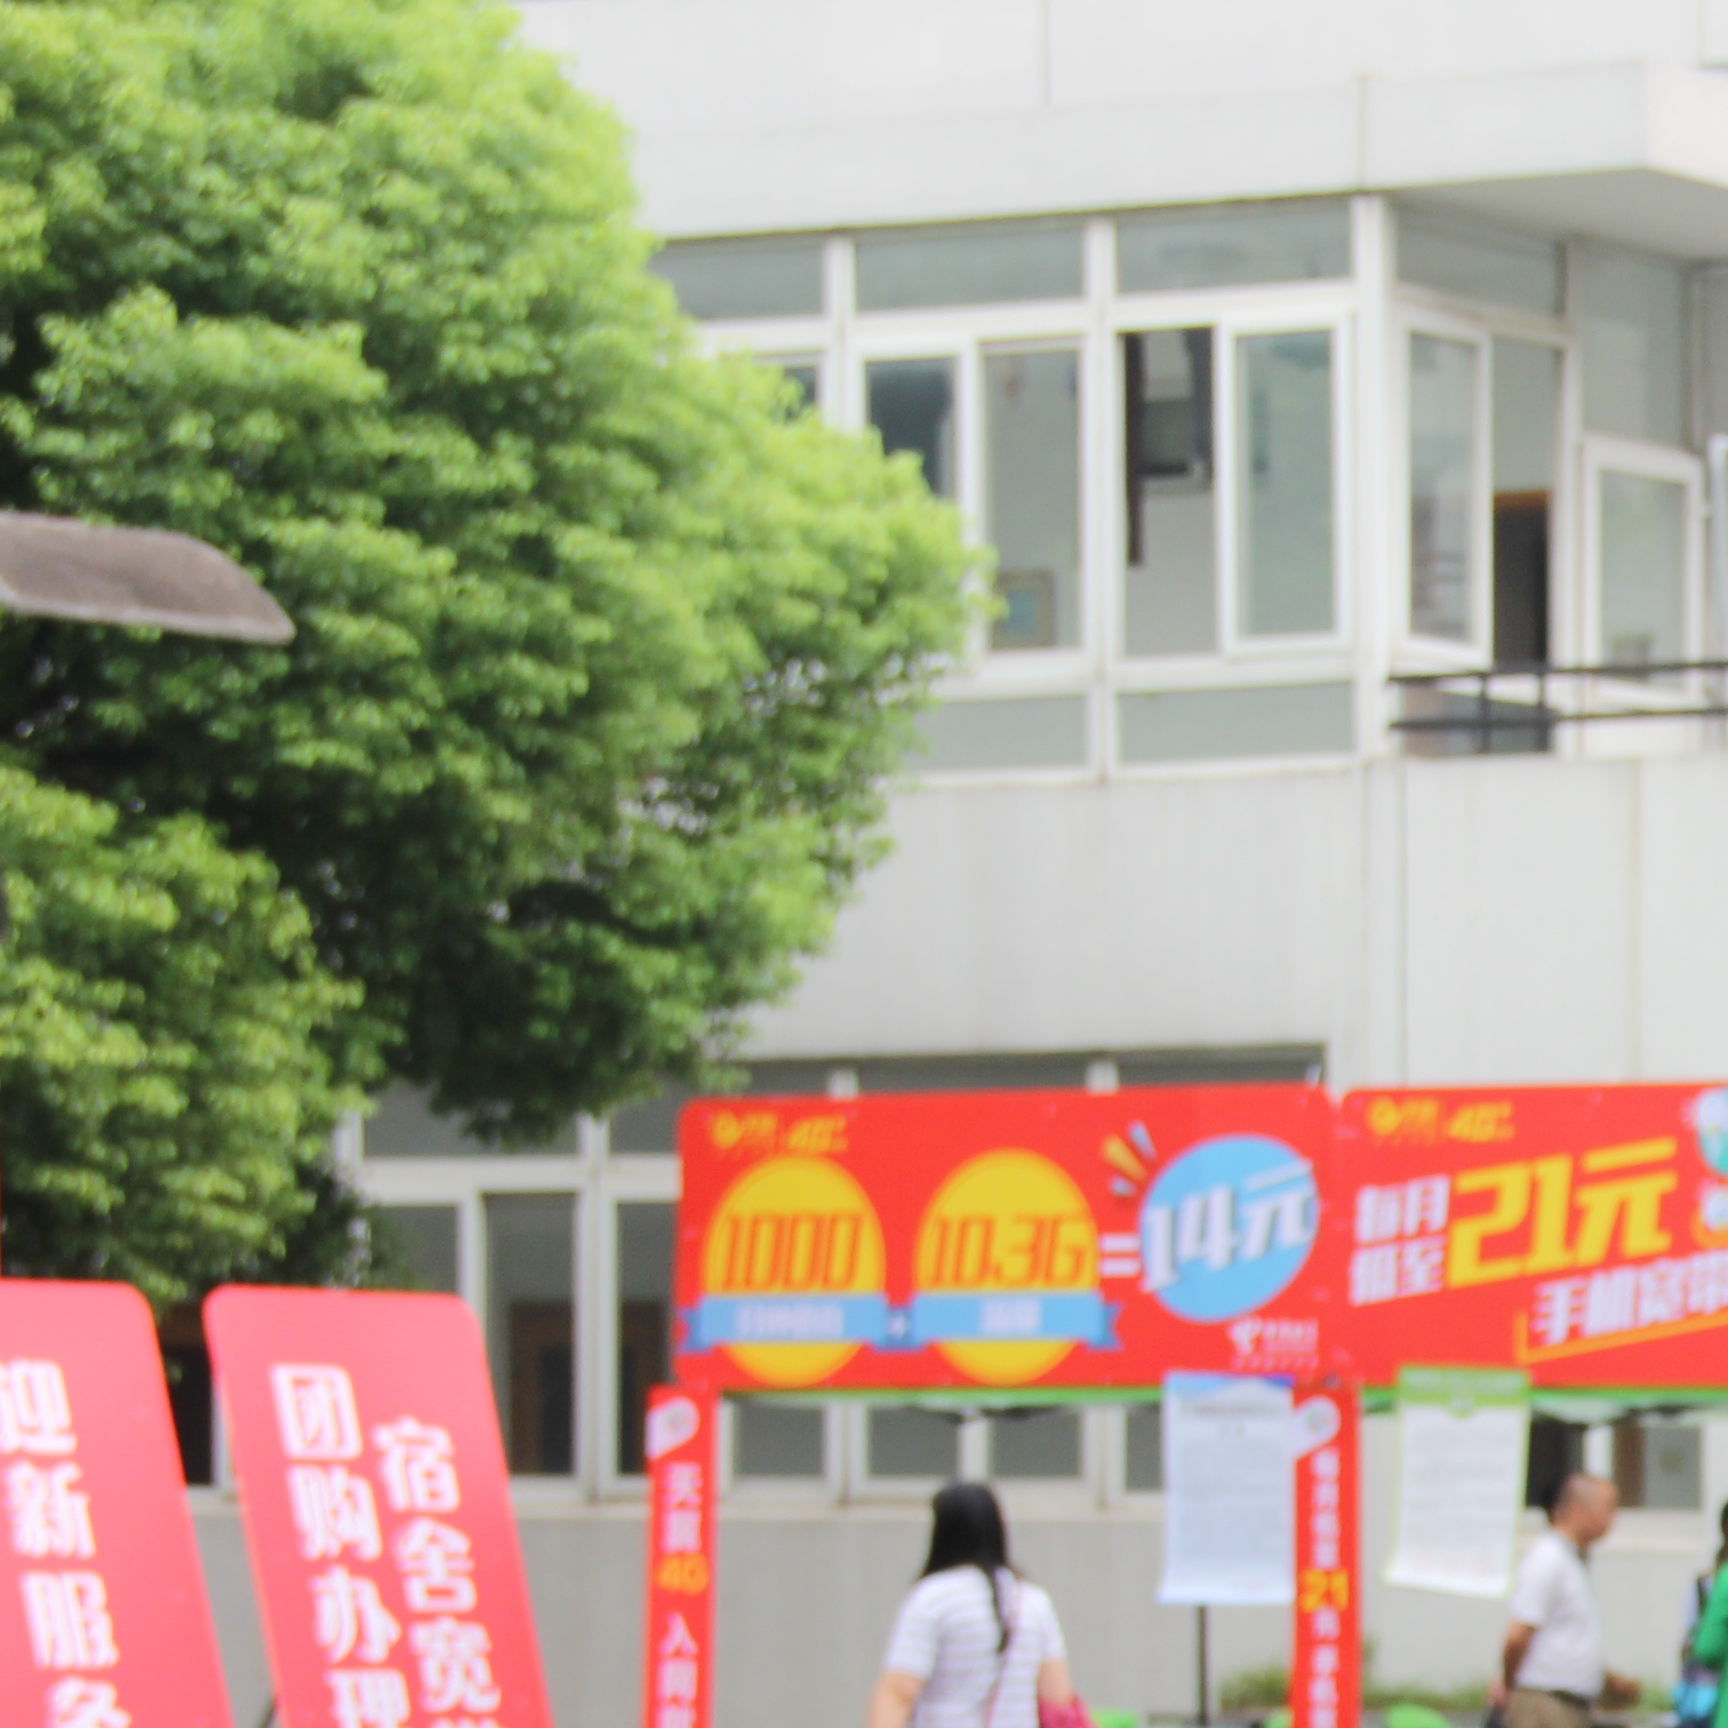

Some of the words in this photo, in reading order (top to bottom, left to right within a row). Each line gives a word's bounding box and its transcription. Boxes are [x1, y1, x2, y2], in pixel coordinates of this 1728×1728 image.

[722, 1213, 864, 1292] 1000
[1140, 1156, 1318, 1294] 14元
[1447, 1136, 1678, 1289] 21元
